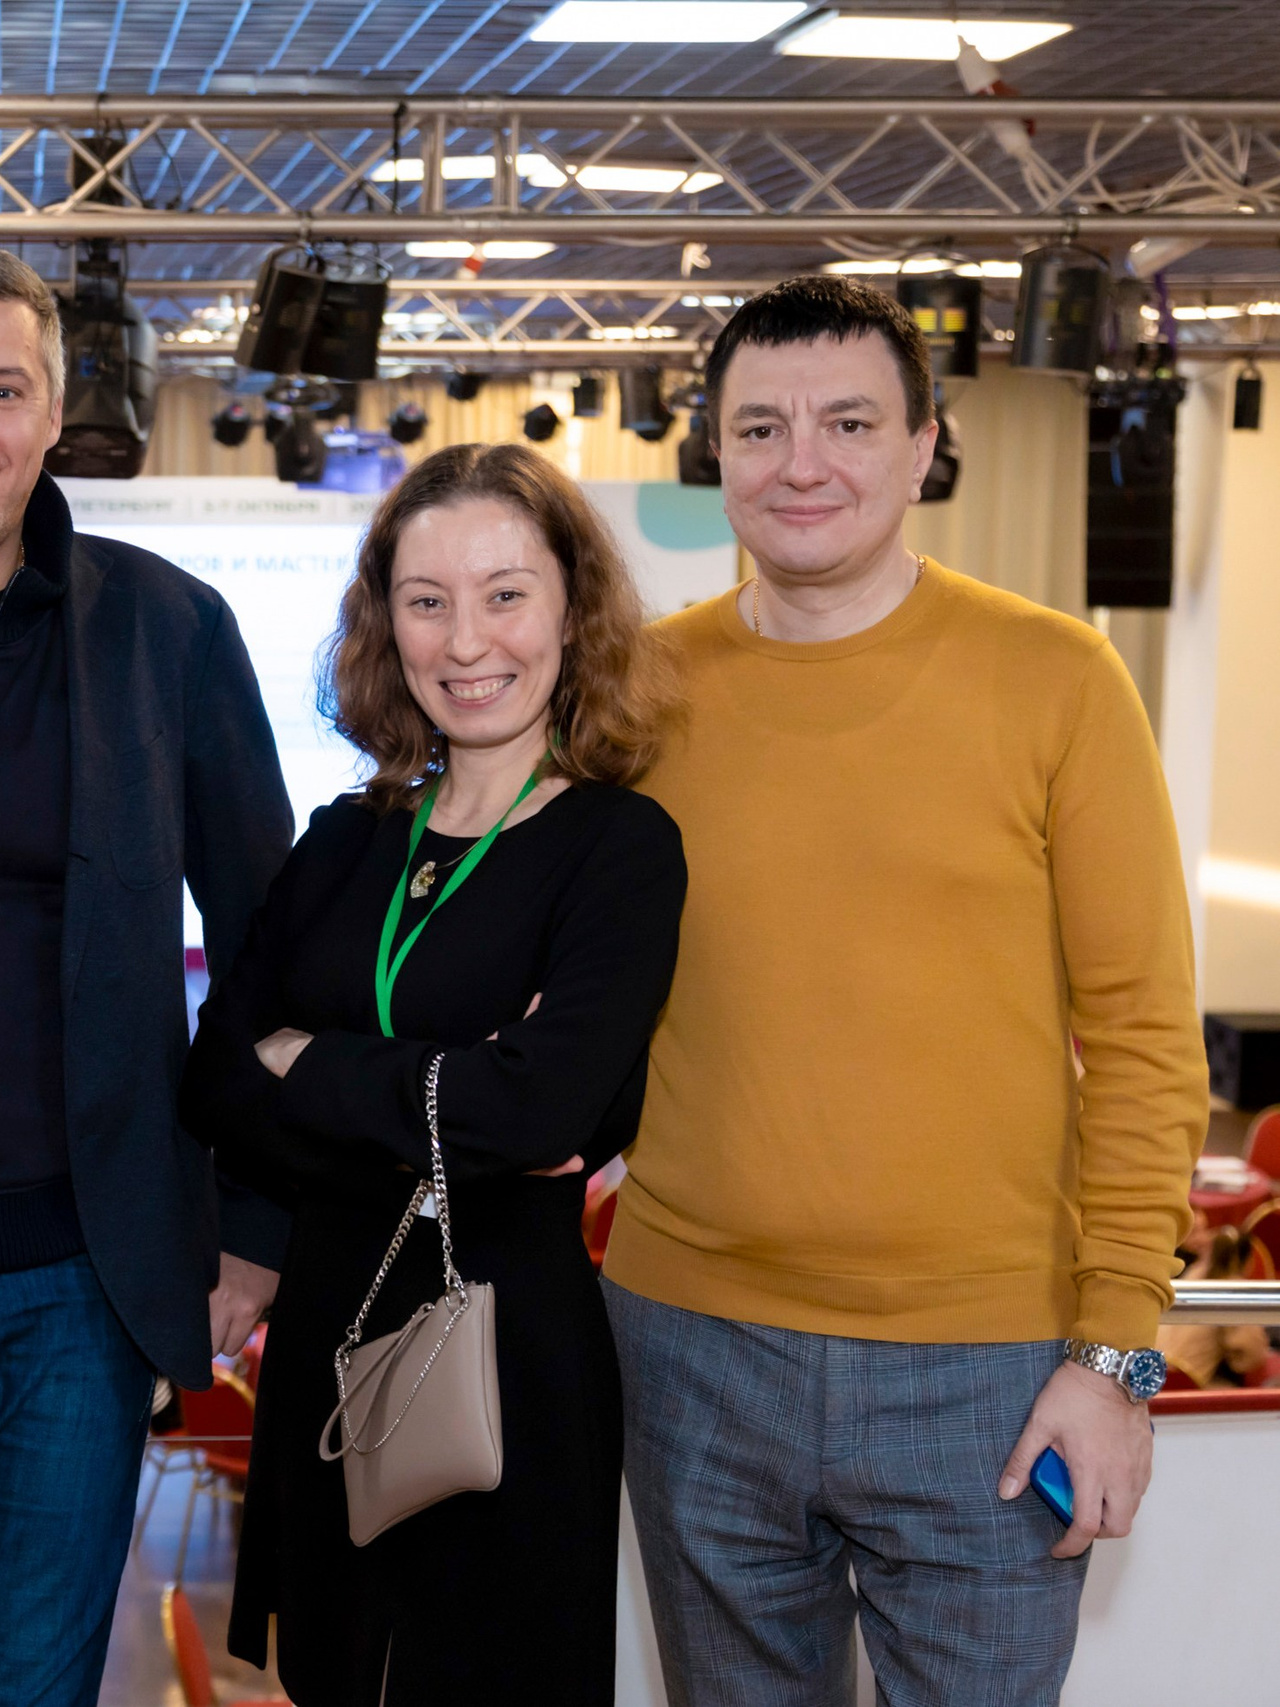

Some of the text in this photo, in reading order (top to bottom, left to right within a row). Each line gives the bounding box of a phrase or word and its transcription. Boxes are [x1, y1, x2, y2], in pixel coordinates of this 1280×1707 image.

[236, 498, 321, 513] ОКТЯБРЯ
[231, 555, 247, 572] И
[255, 554, 352, 573] МАСТЕР
